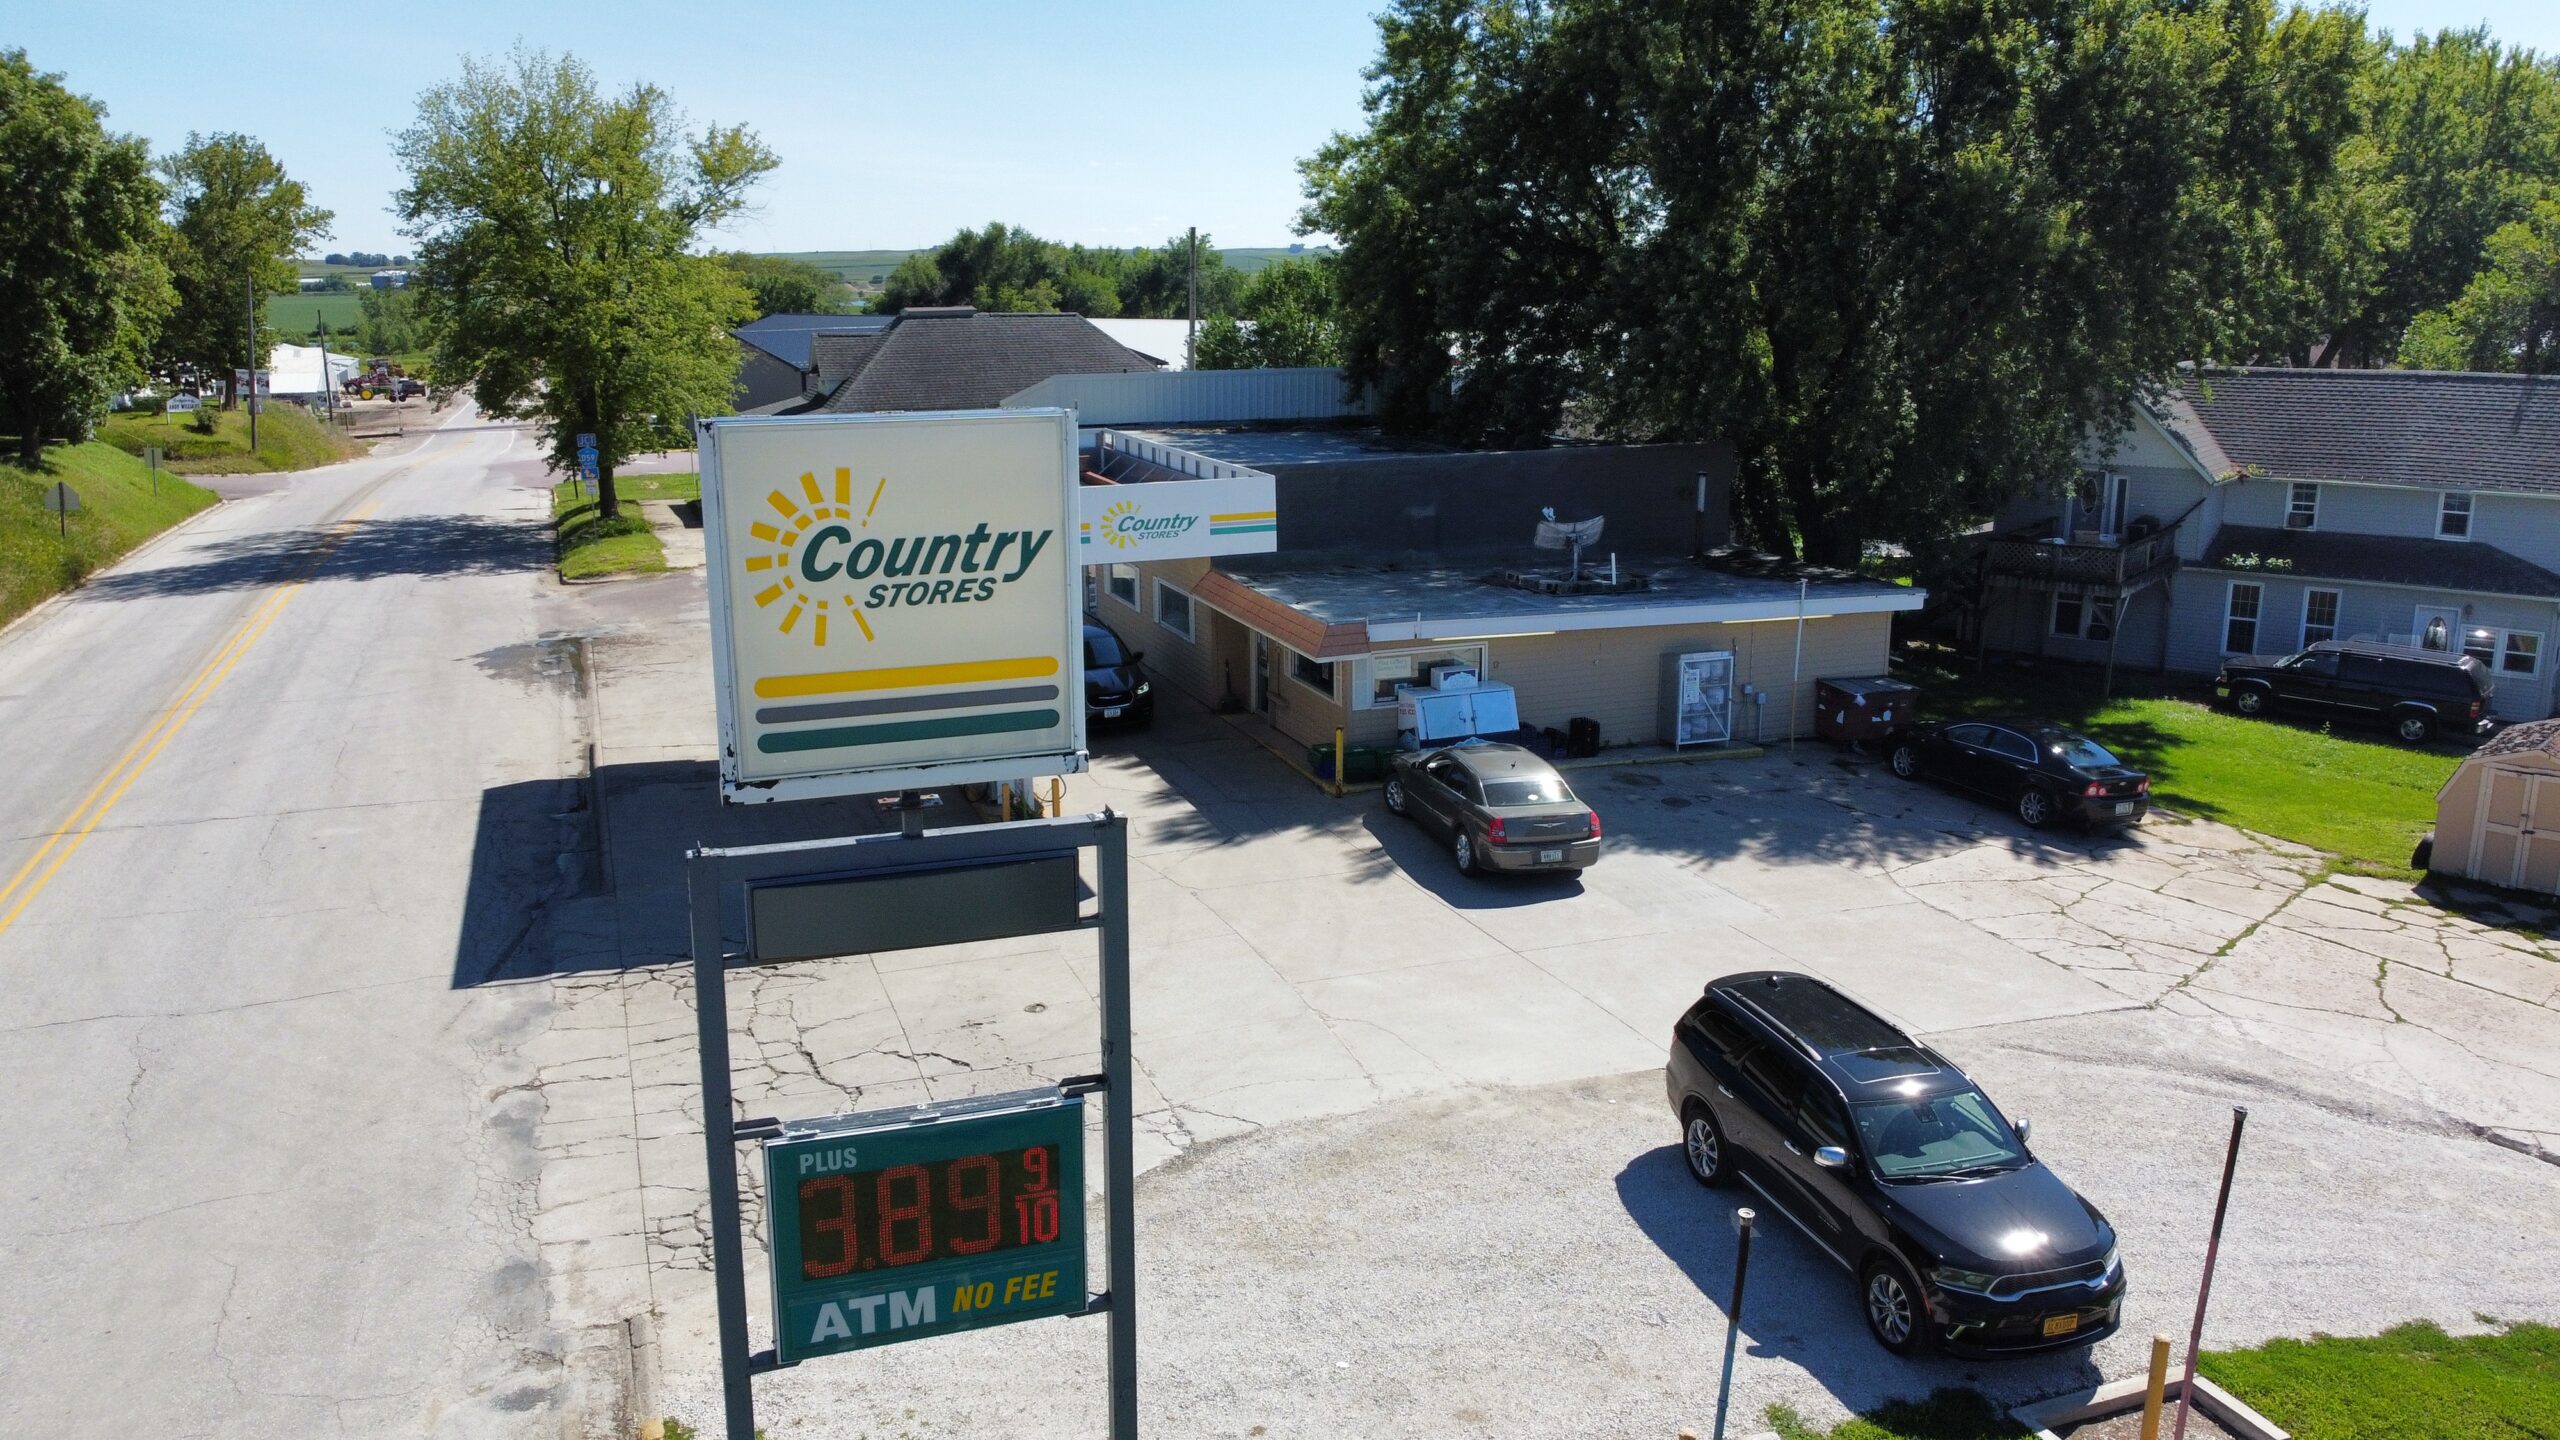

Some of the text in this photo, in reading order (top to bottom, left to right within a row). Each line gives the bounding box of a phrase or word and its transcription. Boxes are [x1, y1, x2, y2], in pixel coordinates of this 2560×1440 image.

[1118, 513, 1199, 532] Country
[1137, 529, 1180, 540] STORES
[801, 523, 1053, 583] Country
[864, 577, 997, 609] STORES
[799, 1147, 858, 1175] PLUS
[800, 1153, 1002, 1279] 3.89
[810, 1270, 1059, 1344] ATM NO FEE
